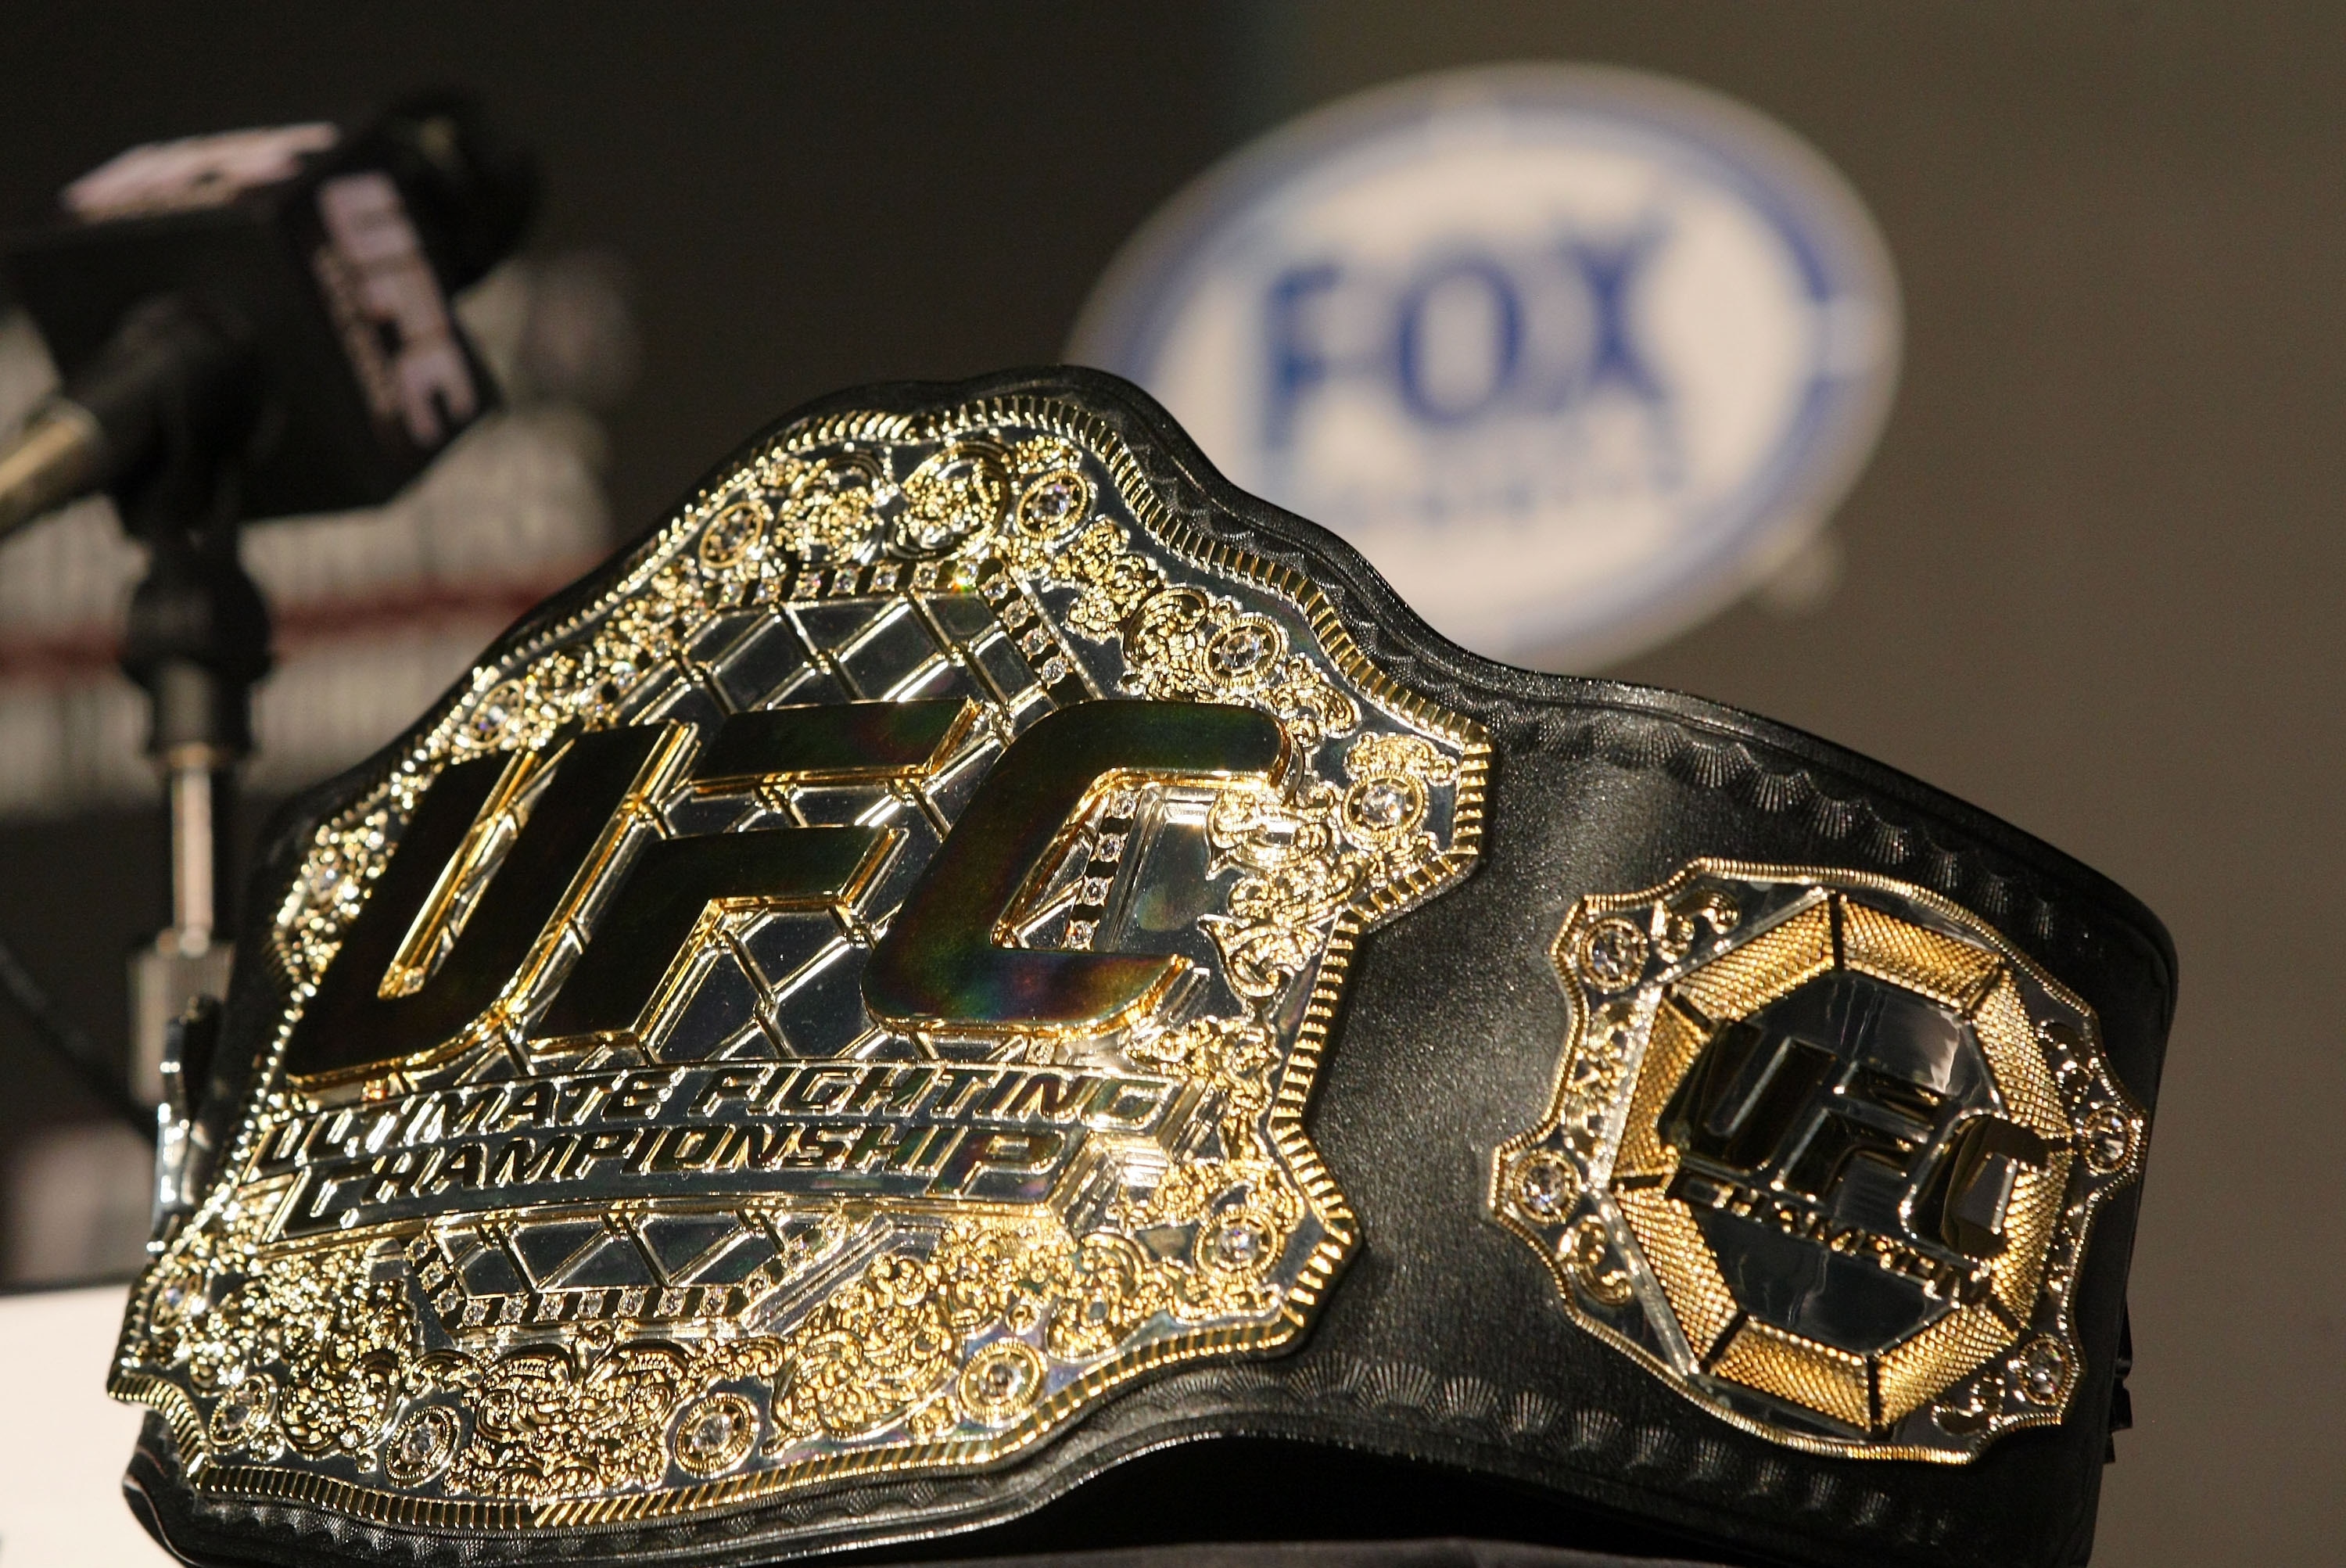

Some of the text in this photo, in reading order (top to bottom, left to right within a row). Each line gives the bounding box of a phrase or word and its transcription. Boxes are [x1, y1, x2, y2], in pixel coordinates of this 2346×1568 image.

[1261, 211, 1670, 477] FOX
[287, 699, 1292, 1078] UFC
[249, 1060, 1173, 1170] ULTIMATE FIGHTING
[264, 1121, 1068, 1239] CHAMPIONSHIP
[1658, 1019, 2050, 1254] UFC
